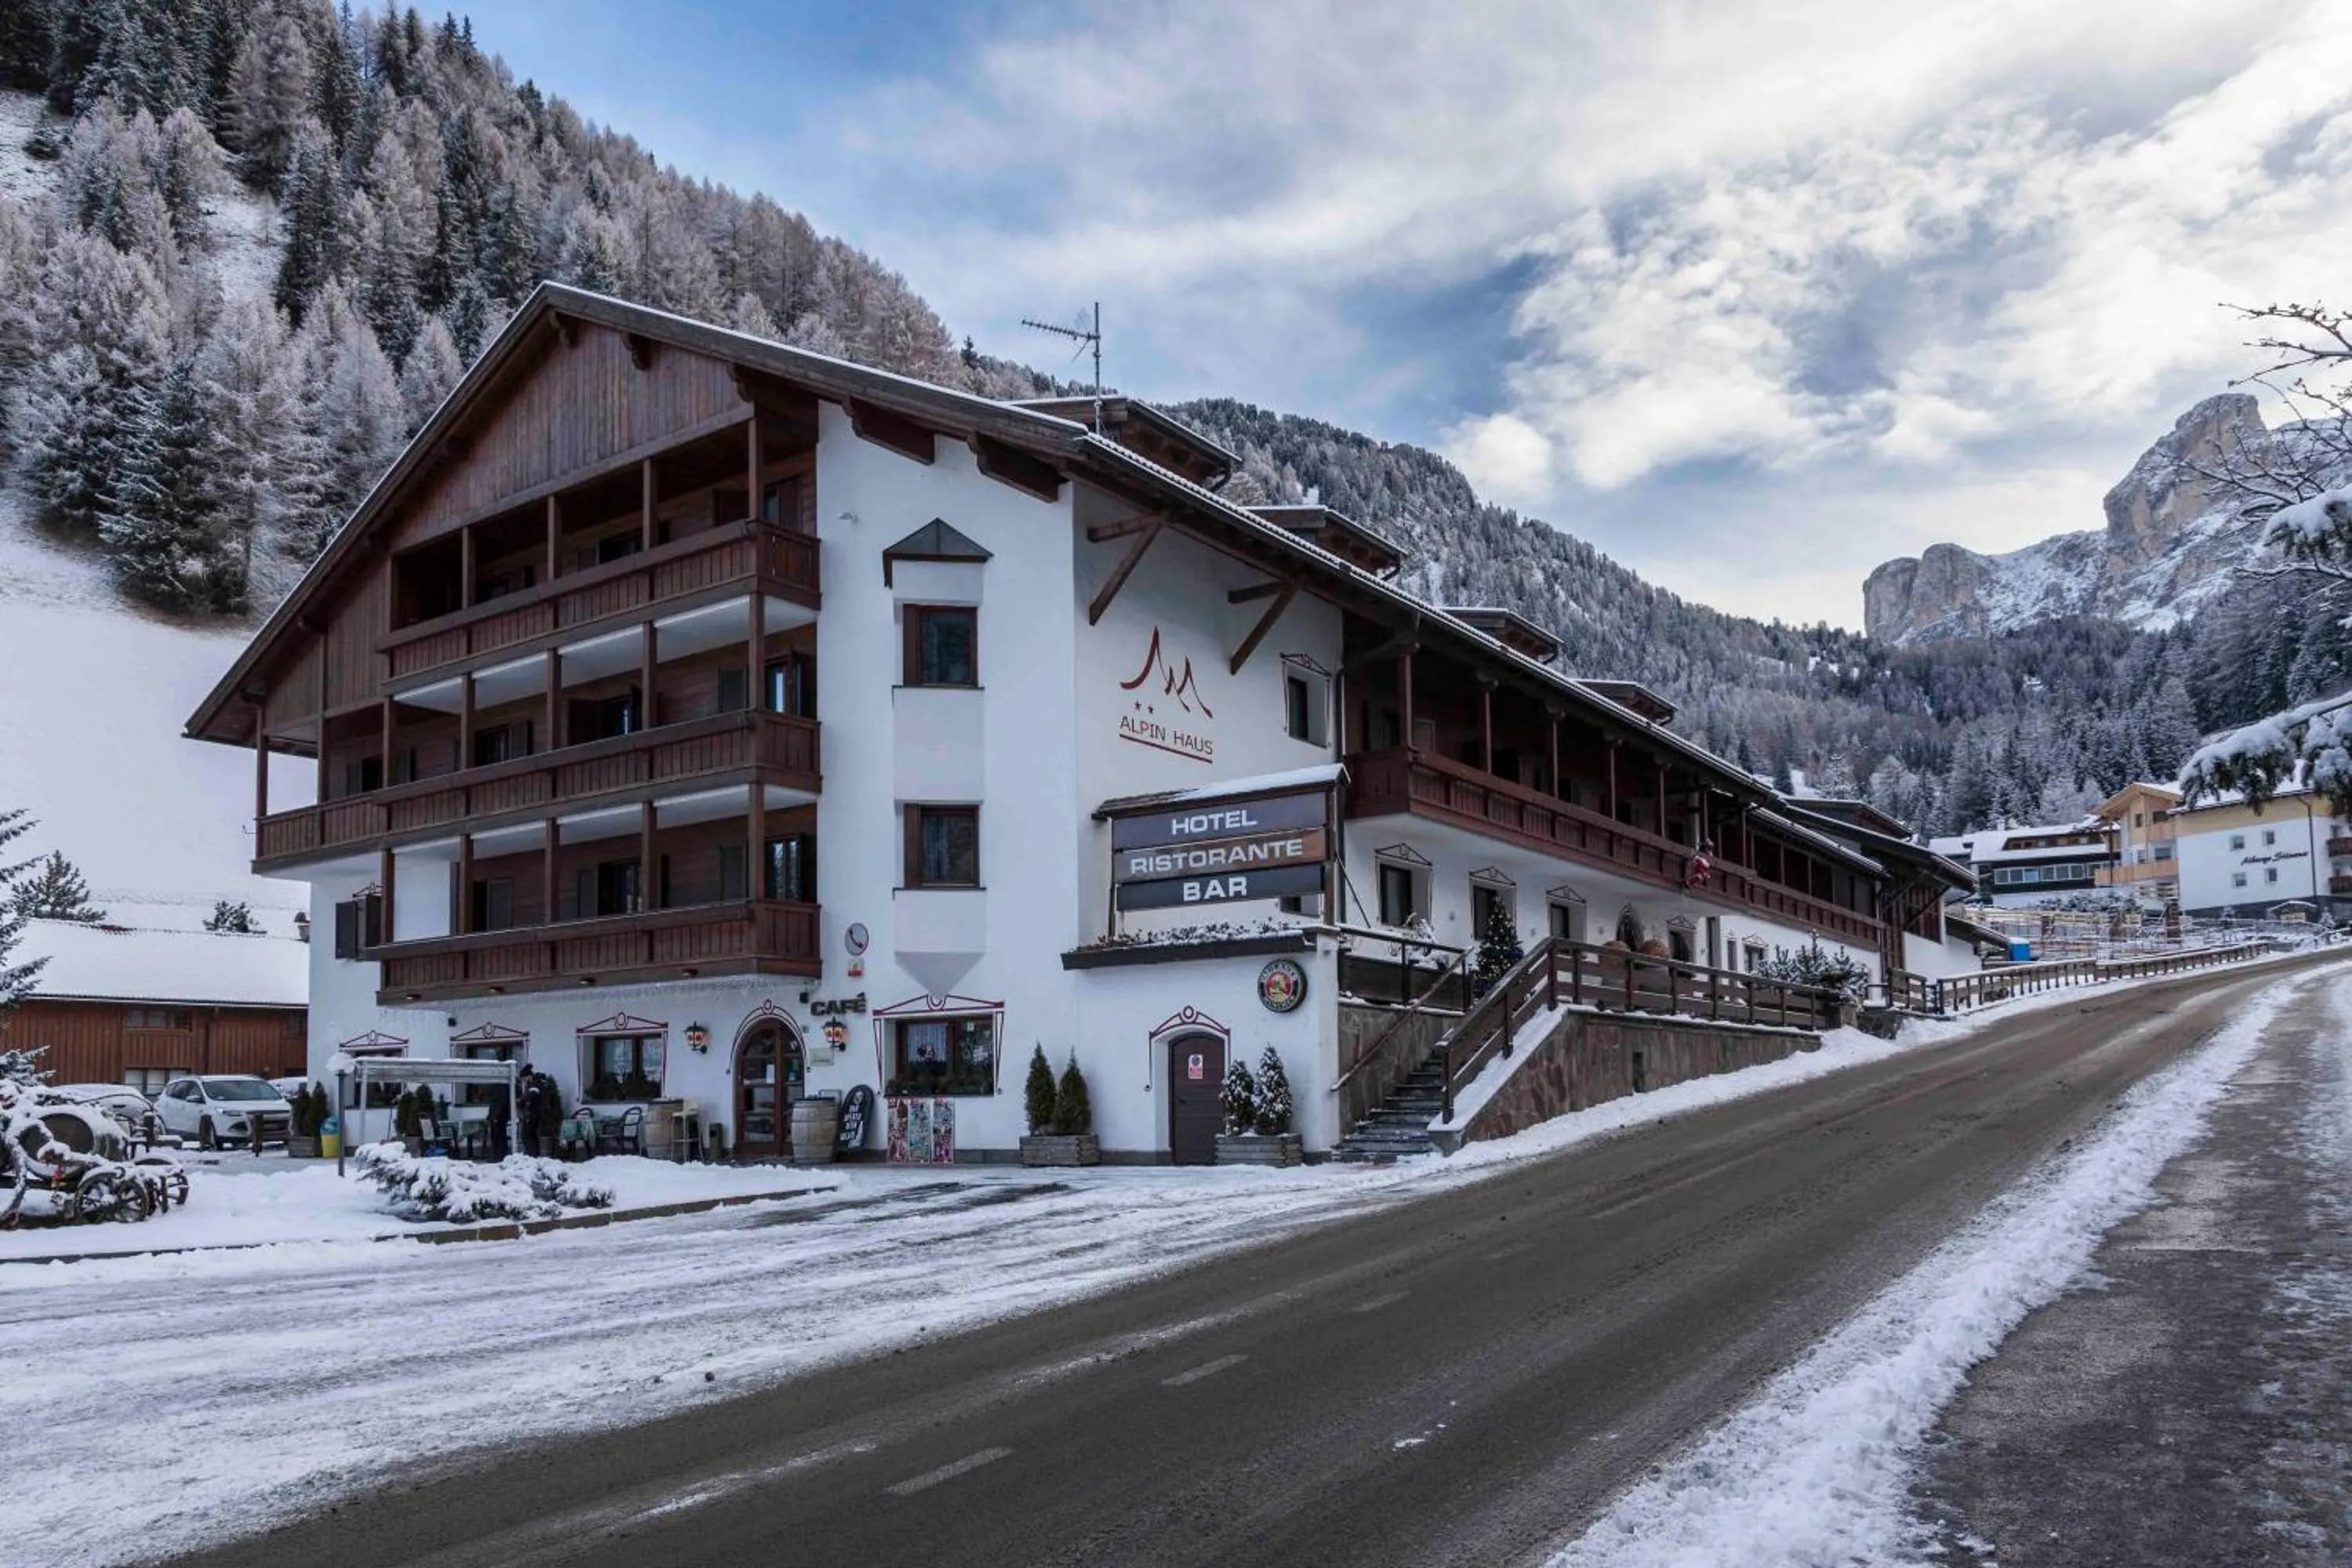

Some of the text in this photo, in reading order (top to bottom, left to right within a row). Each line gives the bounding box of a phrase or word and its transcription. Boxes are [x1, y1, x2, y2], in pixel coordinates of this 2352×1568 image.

[1120, 715, 1214, 755] ALPIN HAUS
[1171, 809, 1258, 835] HOTEL
[1130, 838, 1304, 875] RISTORANTE
[1182, 876, 1248, 902] BAR
[811, 992, 866, 1017] CAFÉ
